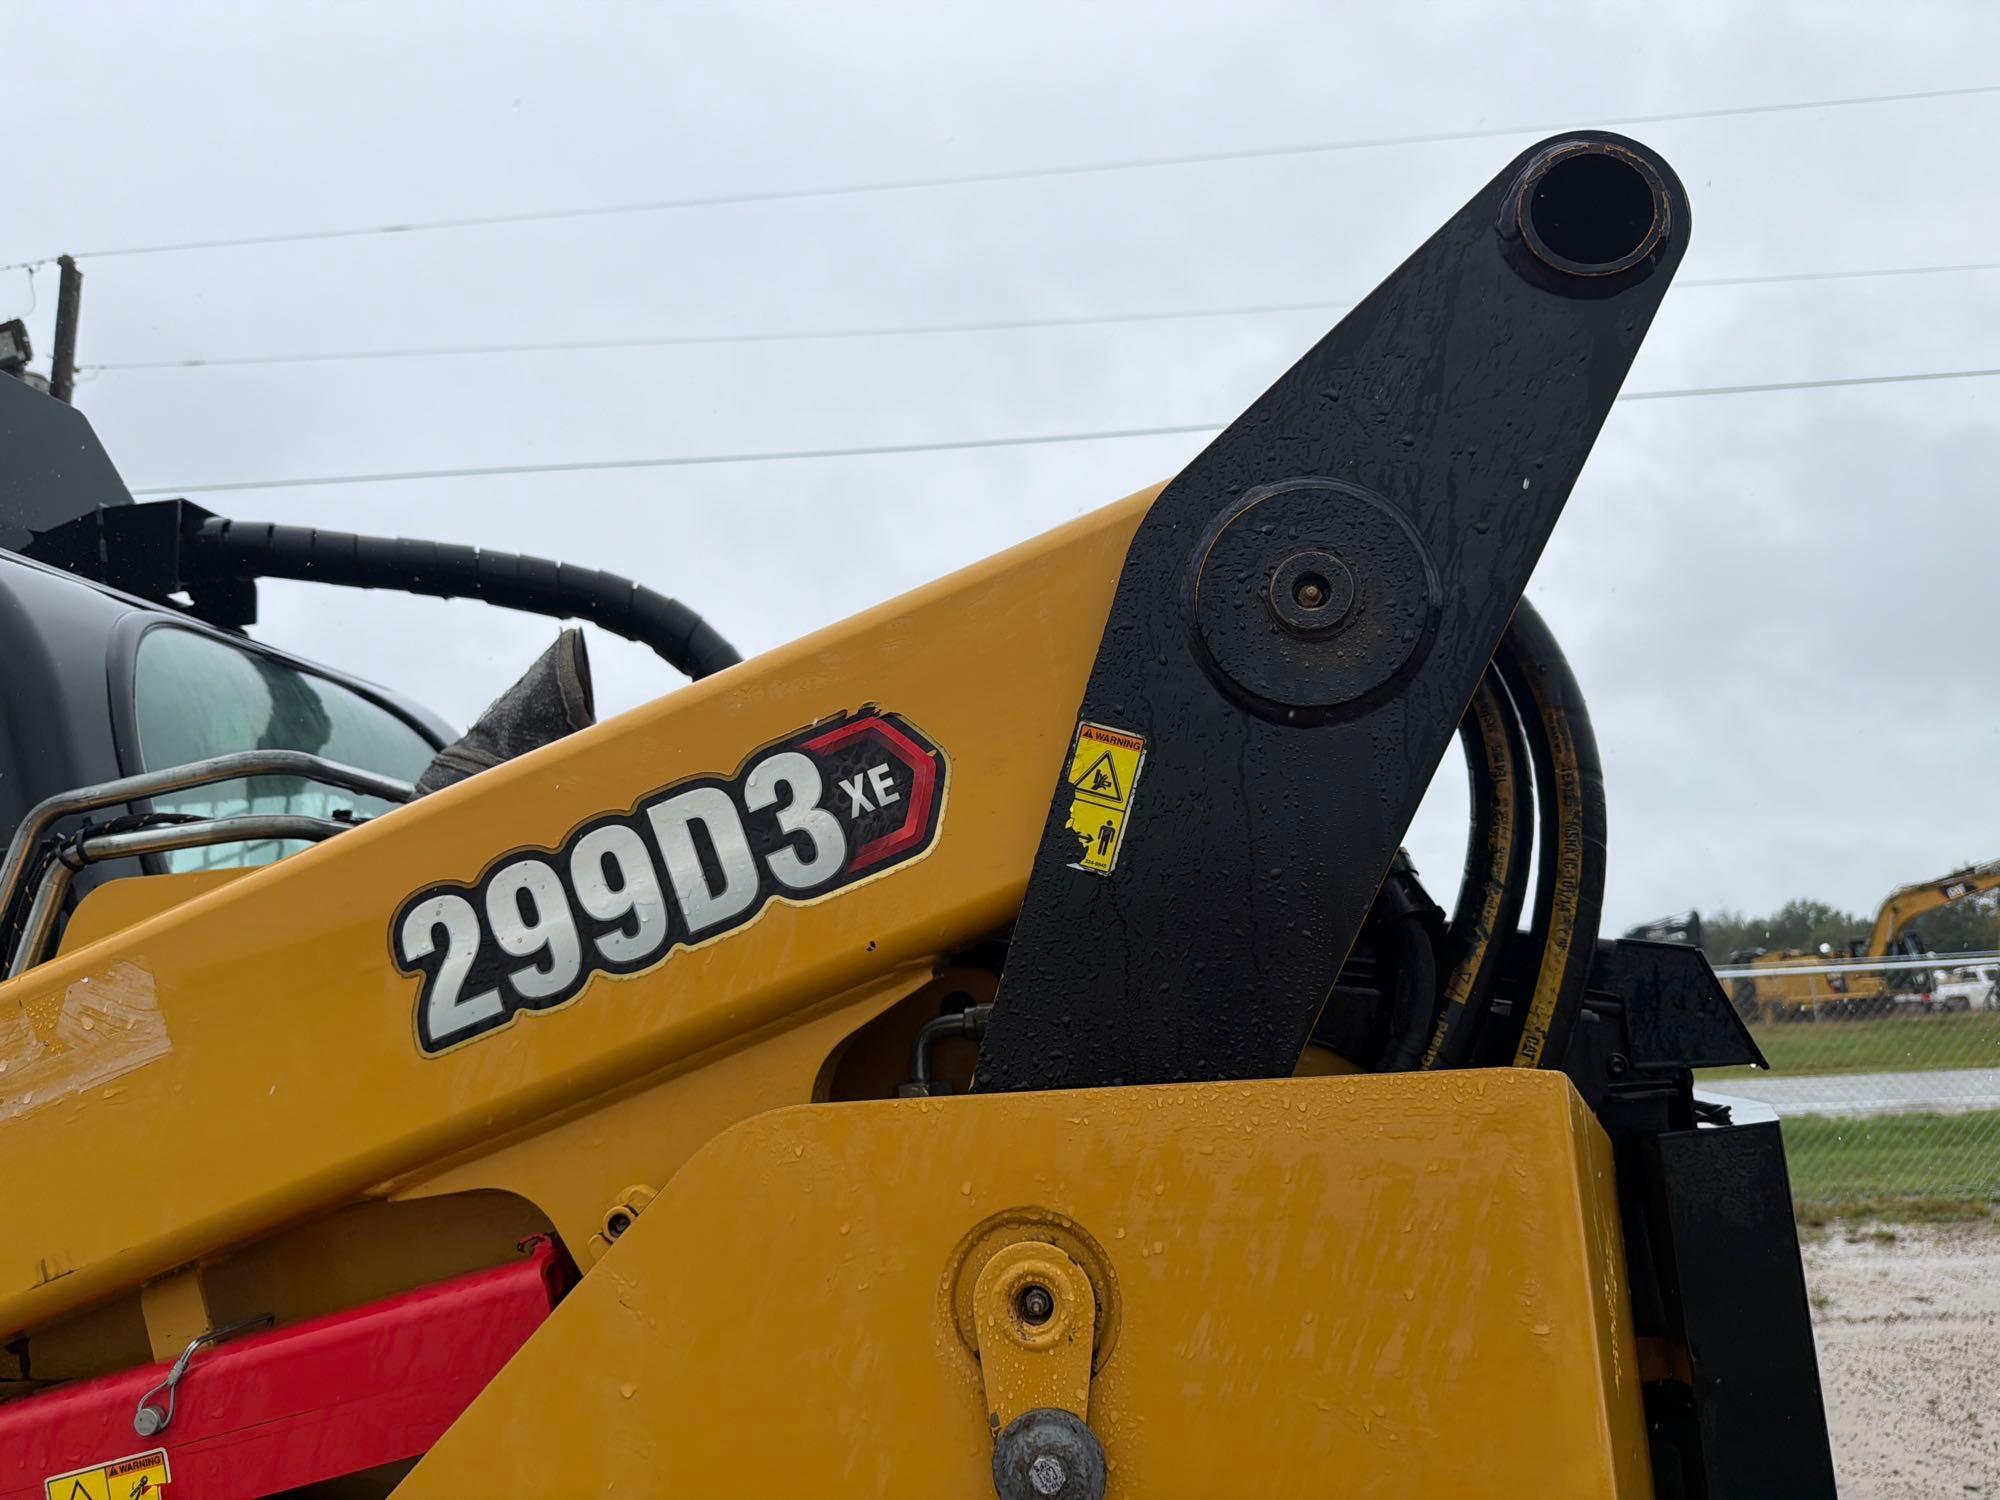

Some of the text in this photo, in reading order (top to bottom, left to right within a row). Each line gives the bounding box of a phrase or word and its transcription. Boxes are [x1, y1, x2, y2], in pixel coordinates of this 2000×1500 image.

[1096, 732, 1141, 750] WARNING
[402, 750, 901, 1041] 299D3 XE
[1421, 1020, 1449, 1070] Guard
[1521, 1035, 1541, 1061] CAT
[119, 1455, 161, 1473] WARNING
